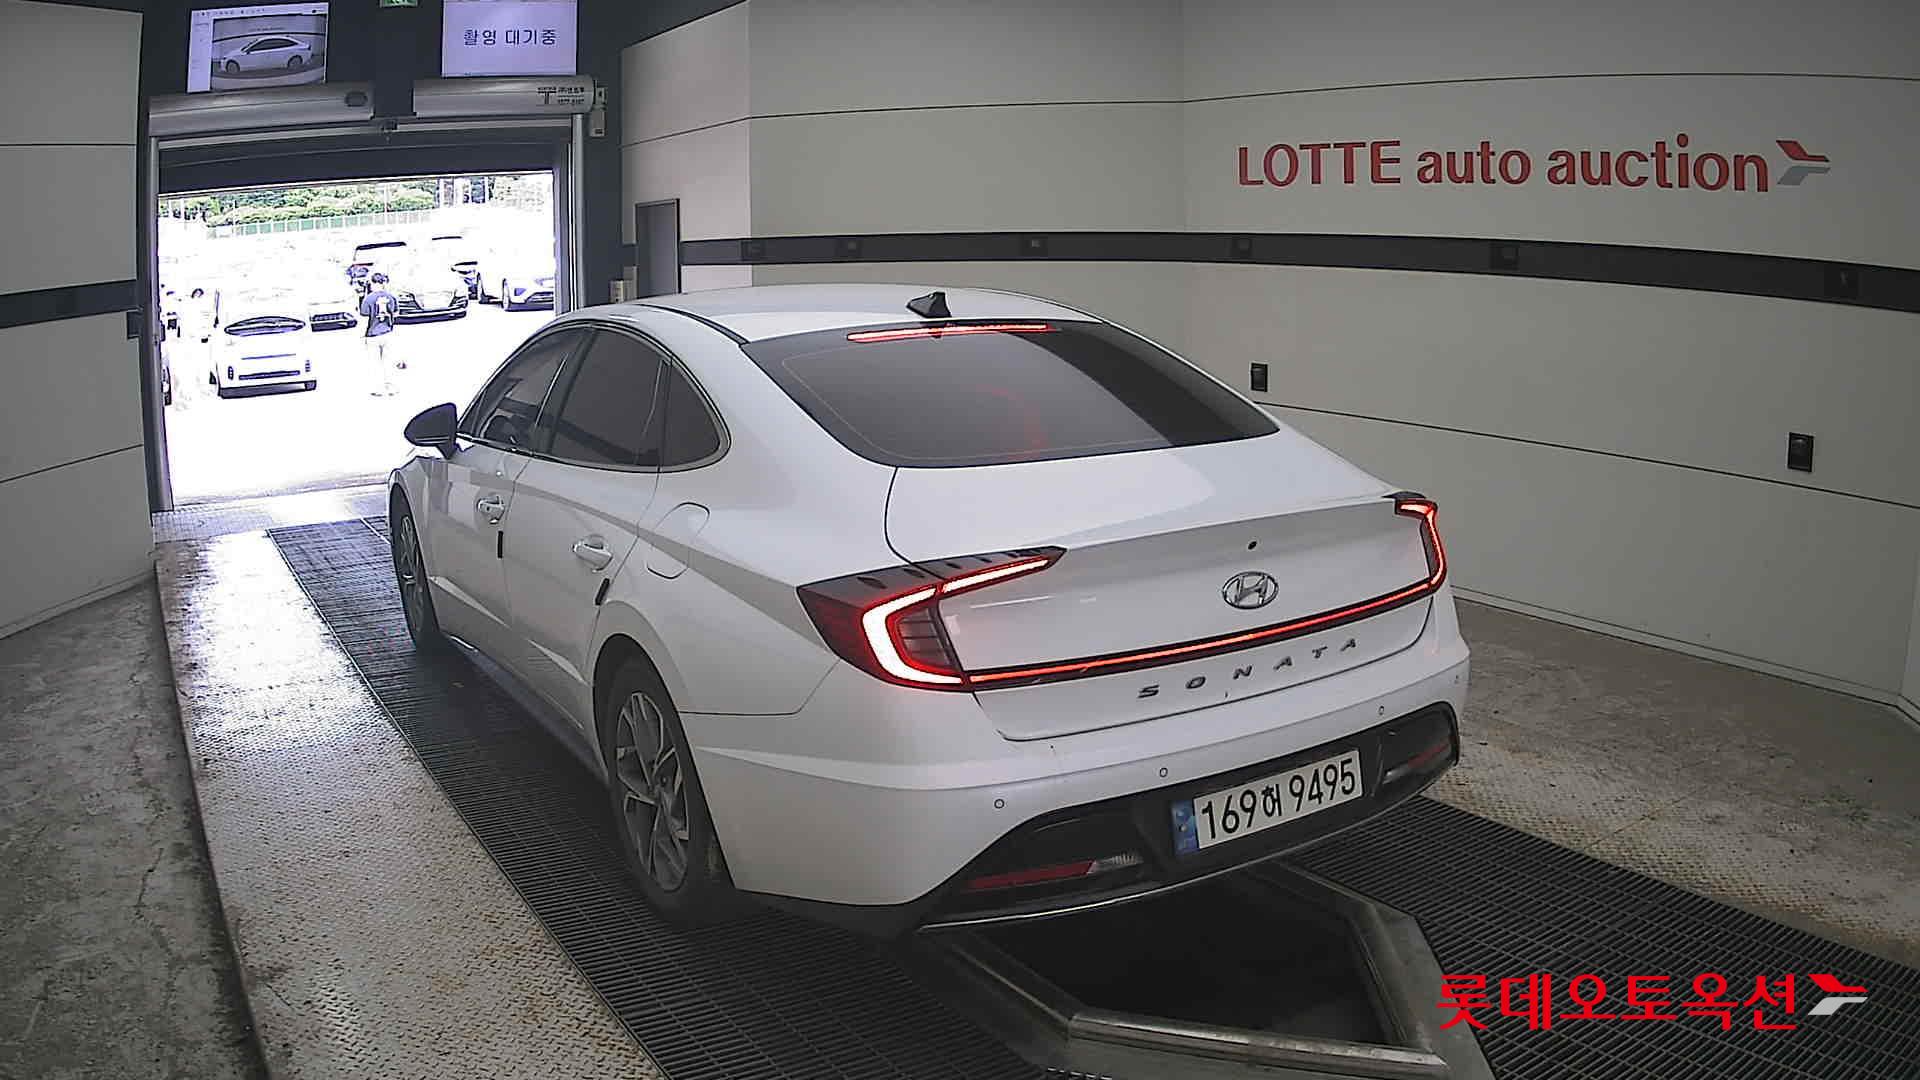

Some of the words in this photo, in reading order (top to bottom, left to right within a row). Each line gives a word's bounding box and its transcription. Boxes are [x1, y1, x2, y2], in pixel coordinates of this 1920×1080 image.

[463, 29, 497, 46] 촬영
[505, 29, 557, 46] 대기중
[1238, 140, 1401, 186] LOTTE
[1416, 140, 1532, 185] auto
[1547, 134, 1768, 192] auction
[1137, 638, 1357, 698] SONATA
[1201, 783, 1282, 840] 169허
[1288, 757, 1356, 813] 9495
